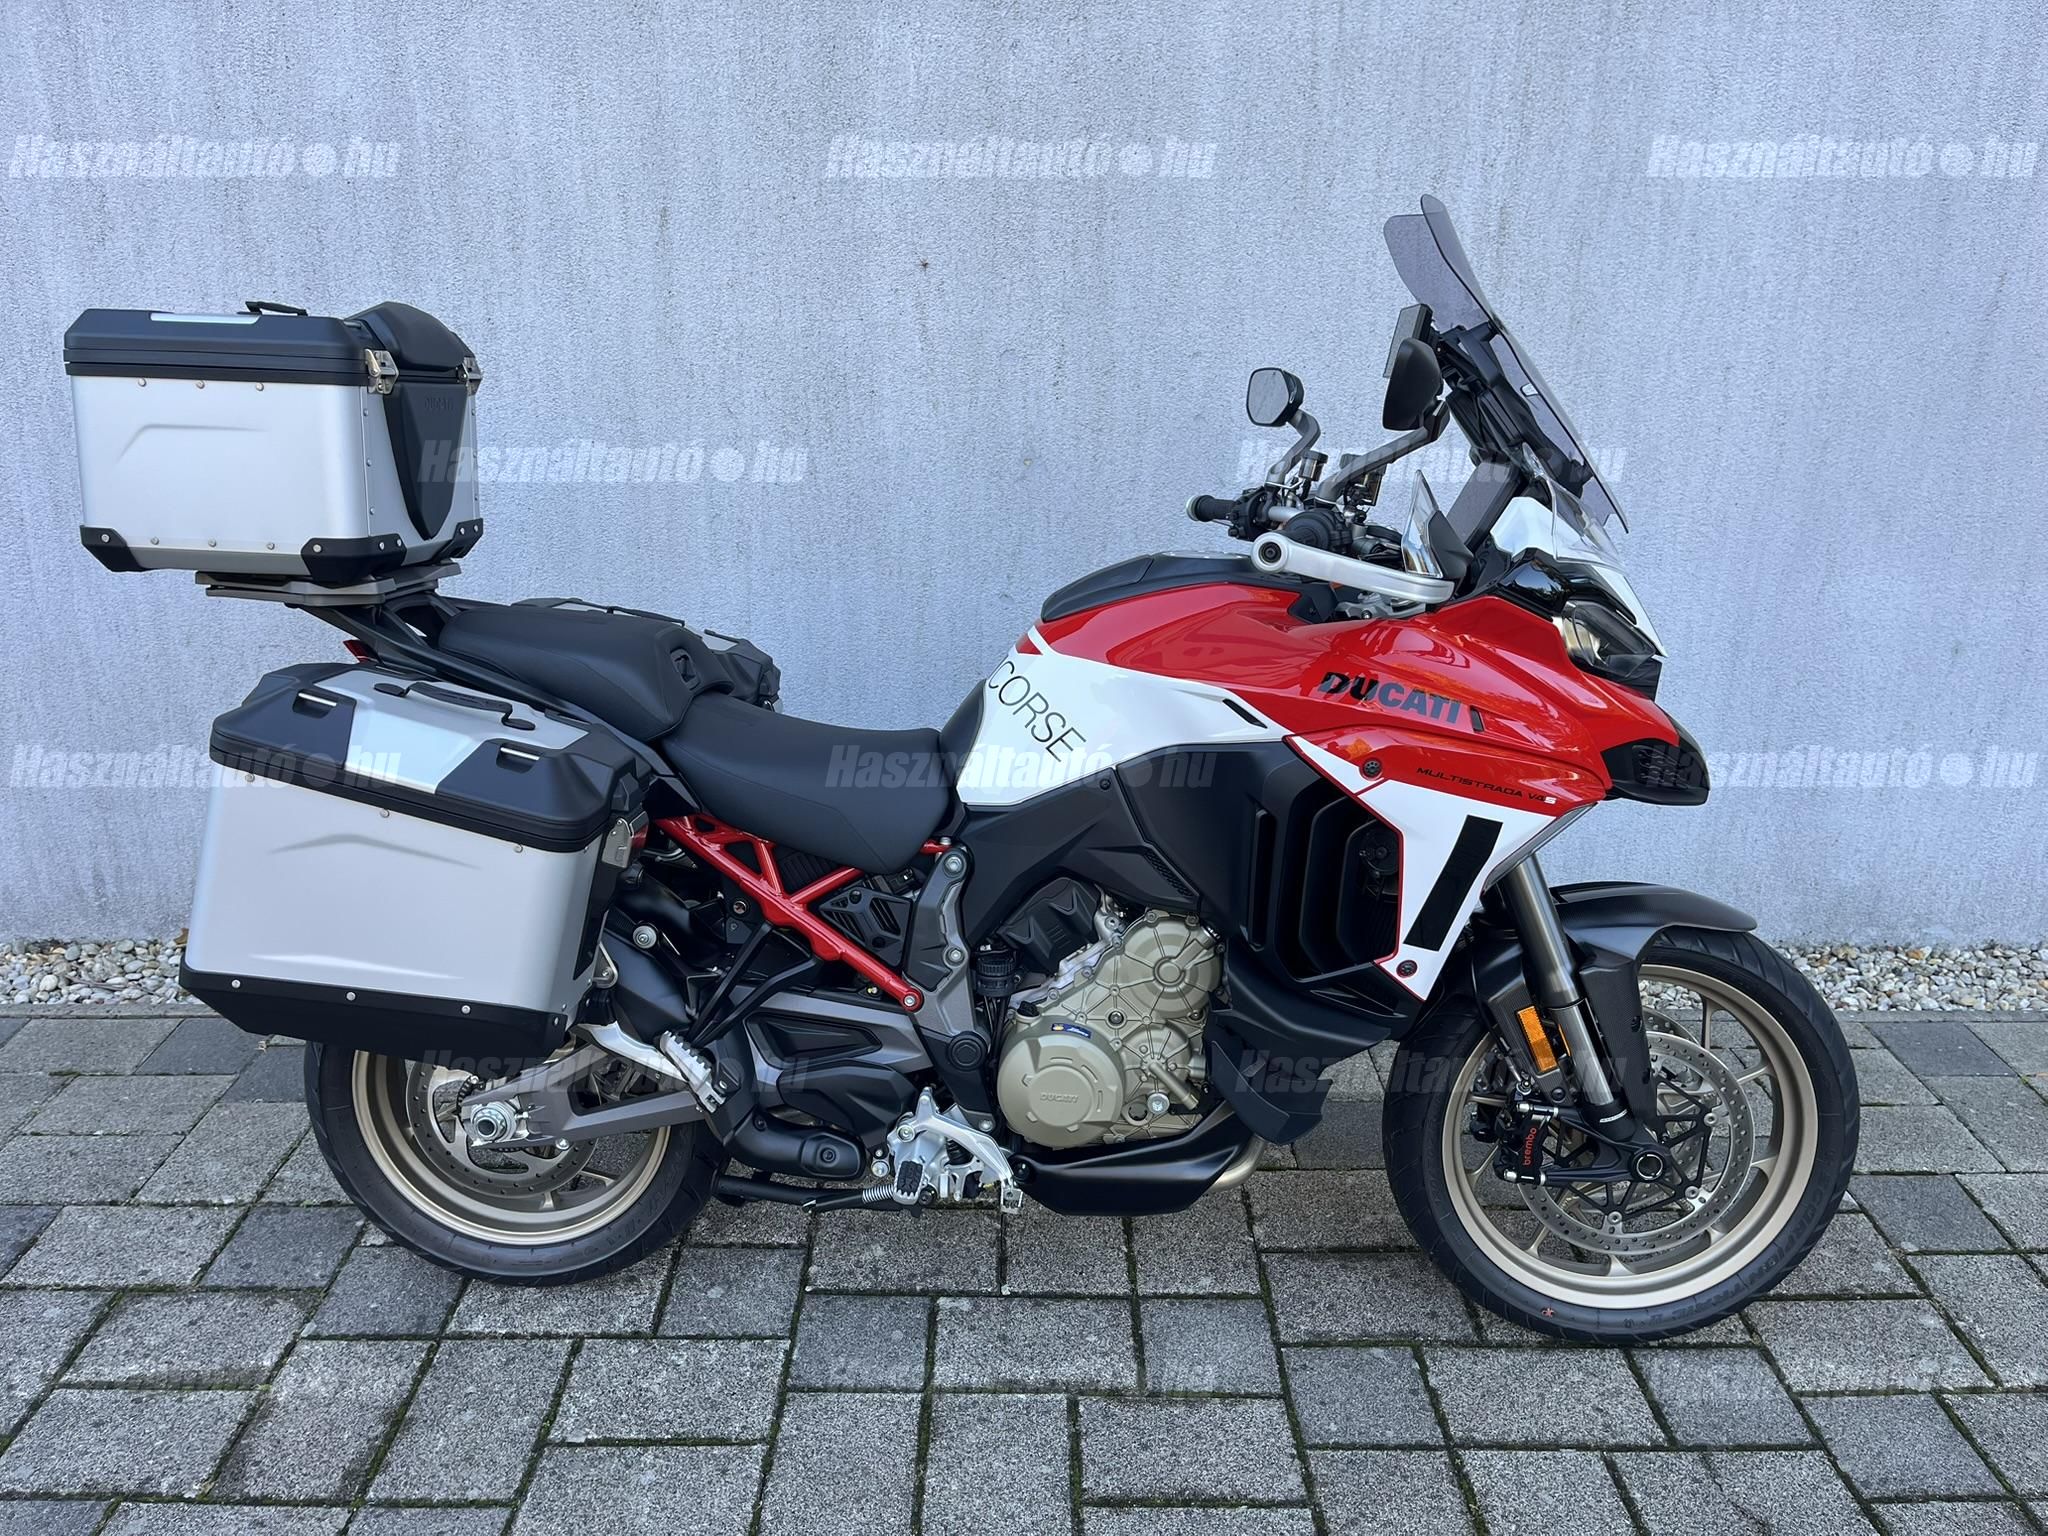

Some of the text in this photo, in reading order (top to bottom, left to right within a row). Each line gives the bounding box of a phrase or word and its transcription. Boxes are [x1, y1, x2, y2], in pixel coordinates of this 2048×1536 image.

[988, 660, 1087, 762] CORSE
[1317, 671, 1462, 724] DUCATI
[1416, 766, 1523, 799] MULTISTRADA
[1522, 1127, 1538, 1166] brembo
